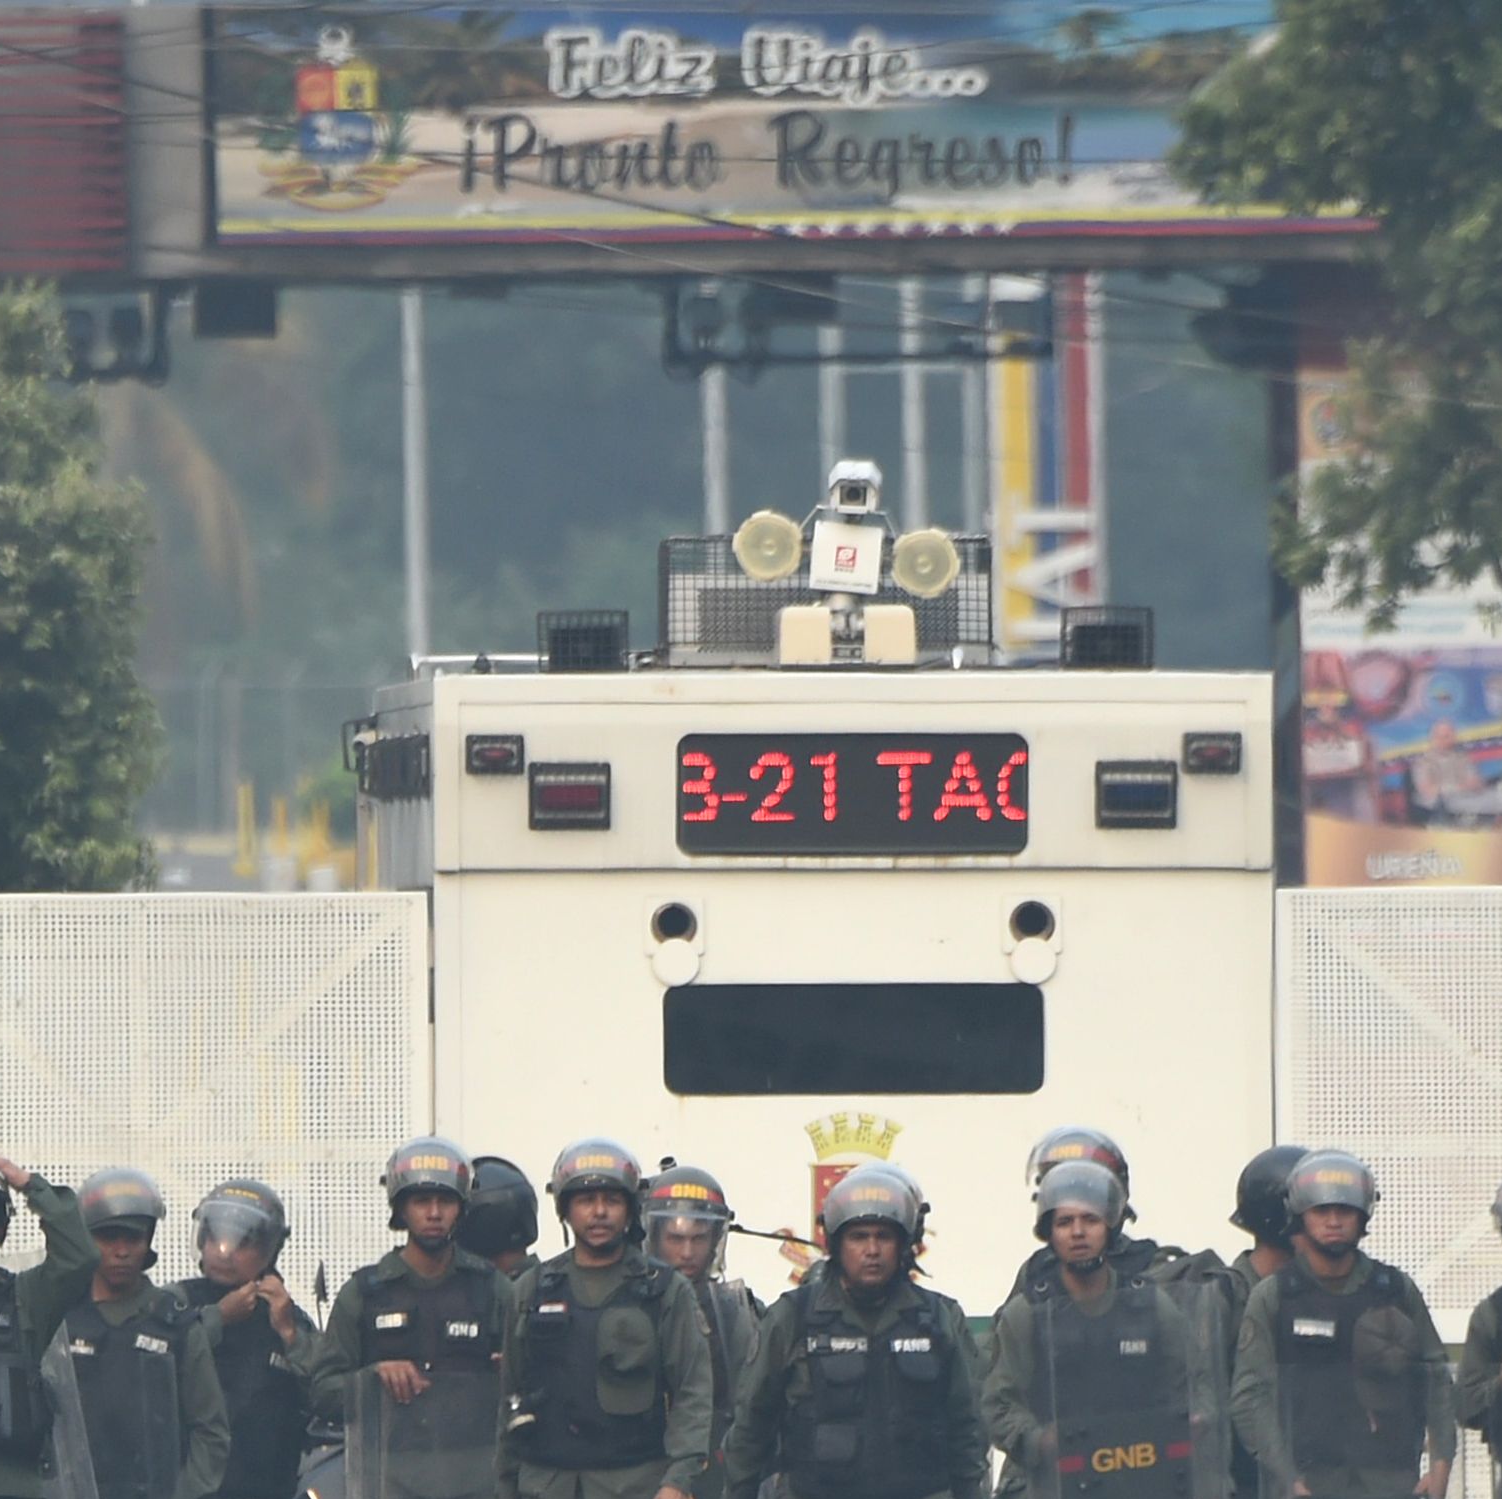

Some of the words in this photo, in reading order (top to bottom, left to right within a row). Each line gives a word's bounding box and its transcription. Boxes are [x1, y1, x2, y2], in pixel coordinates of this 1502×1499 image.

[548, 30, 715, 97] Feliz
[767, 110, 1071, 198] Regreso!
[410, 1156, 448, 1170] GNB
[671, 1184, 708, 1199] GNB
[893, 1338, 931, 1352] FANB
[1090, 1442, 1156, 1472] GNB
